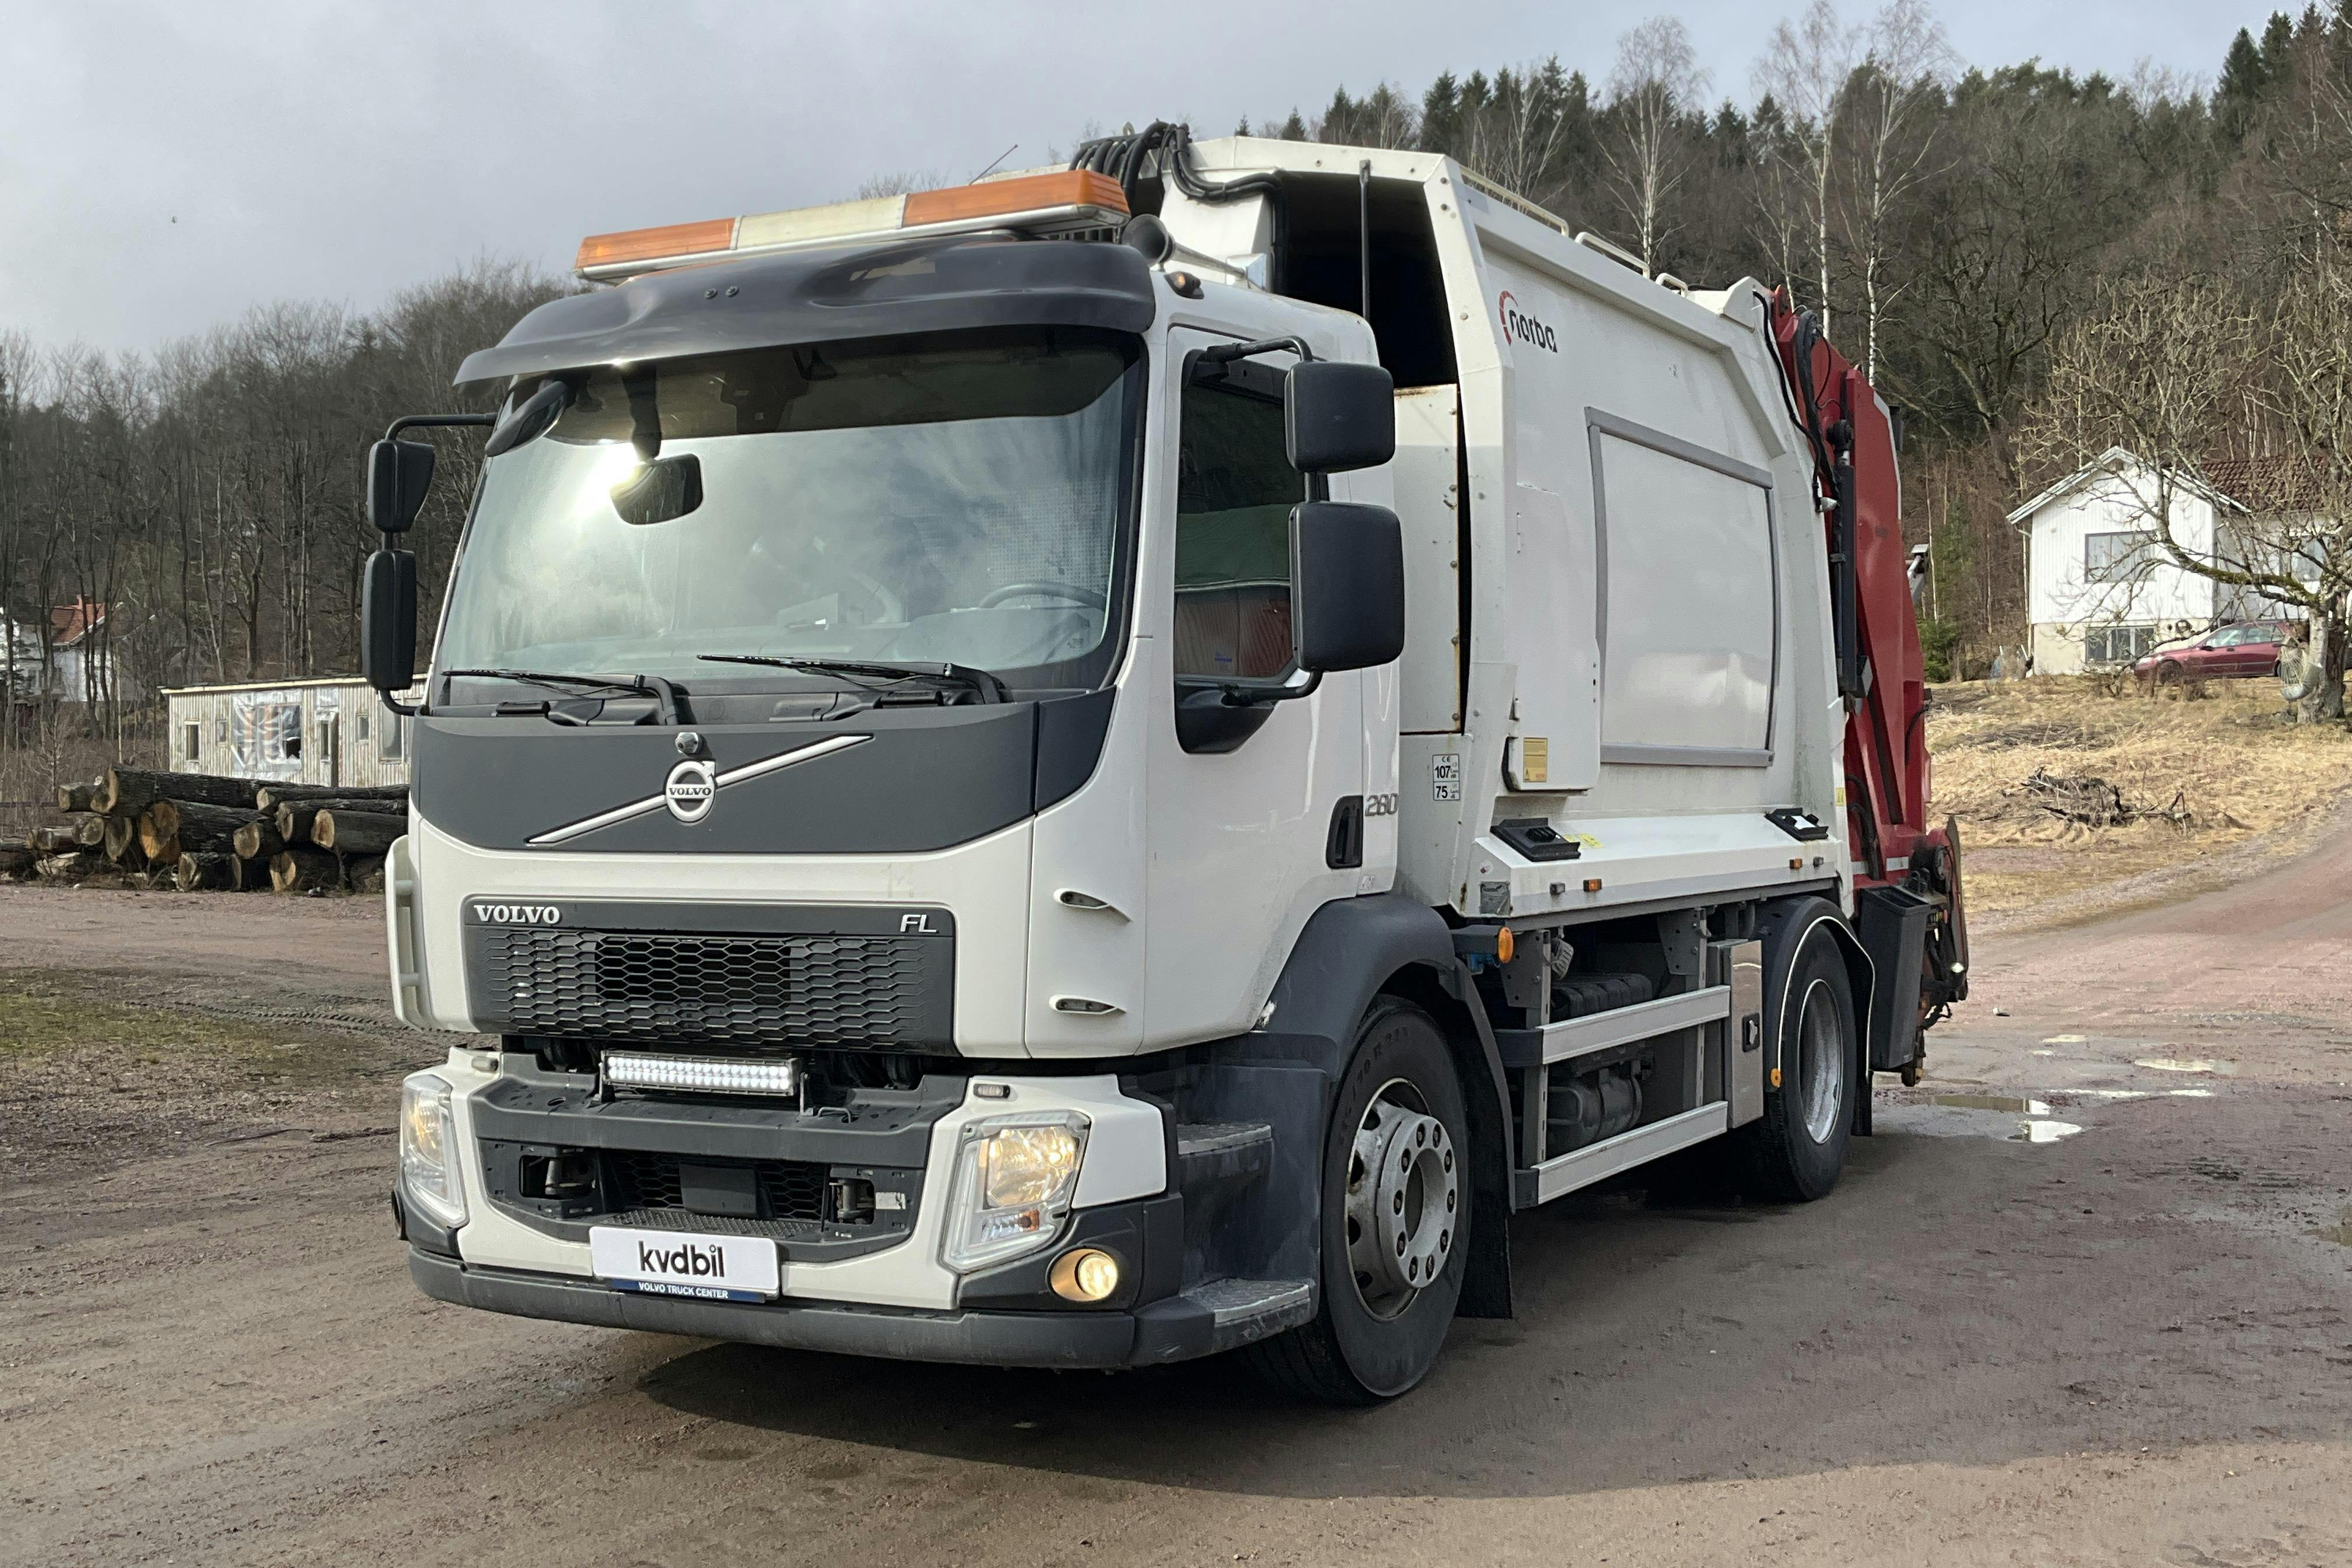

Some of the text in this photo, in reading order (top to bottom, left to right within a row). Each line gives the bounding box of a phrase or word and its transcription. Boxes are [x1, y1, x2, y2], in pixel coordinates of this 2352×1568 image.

[1434, 765, 1451, 779] 107
[668, 788, 712, 796] VOLVO
[1436, 785, 1448, 799] 75
[1365, 793, 1399, 817] 280
[473, 905, 561, 925] VOLVO
[900, 914, 937, 933] FL
[638, 1240, 725, 1278] kvdbil
[638, 1282, 729, 1299] VOLVO TRUCK CENTER
